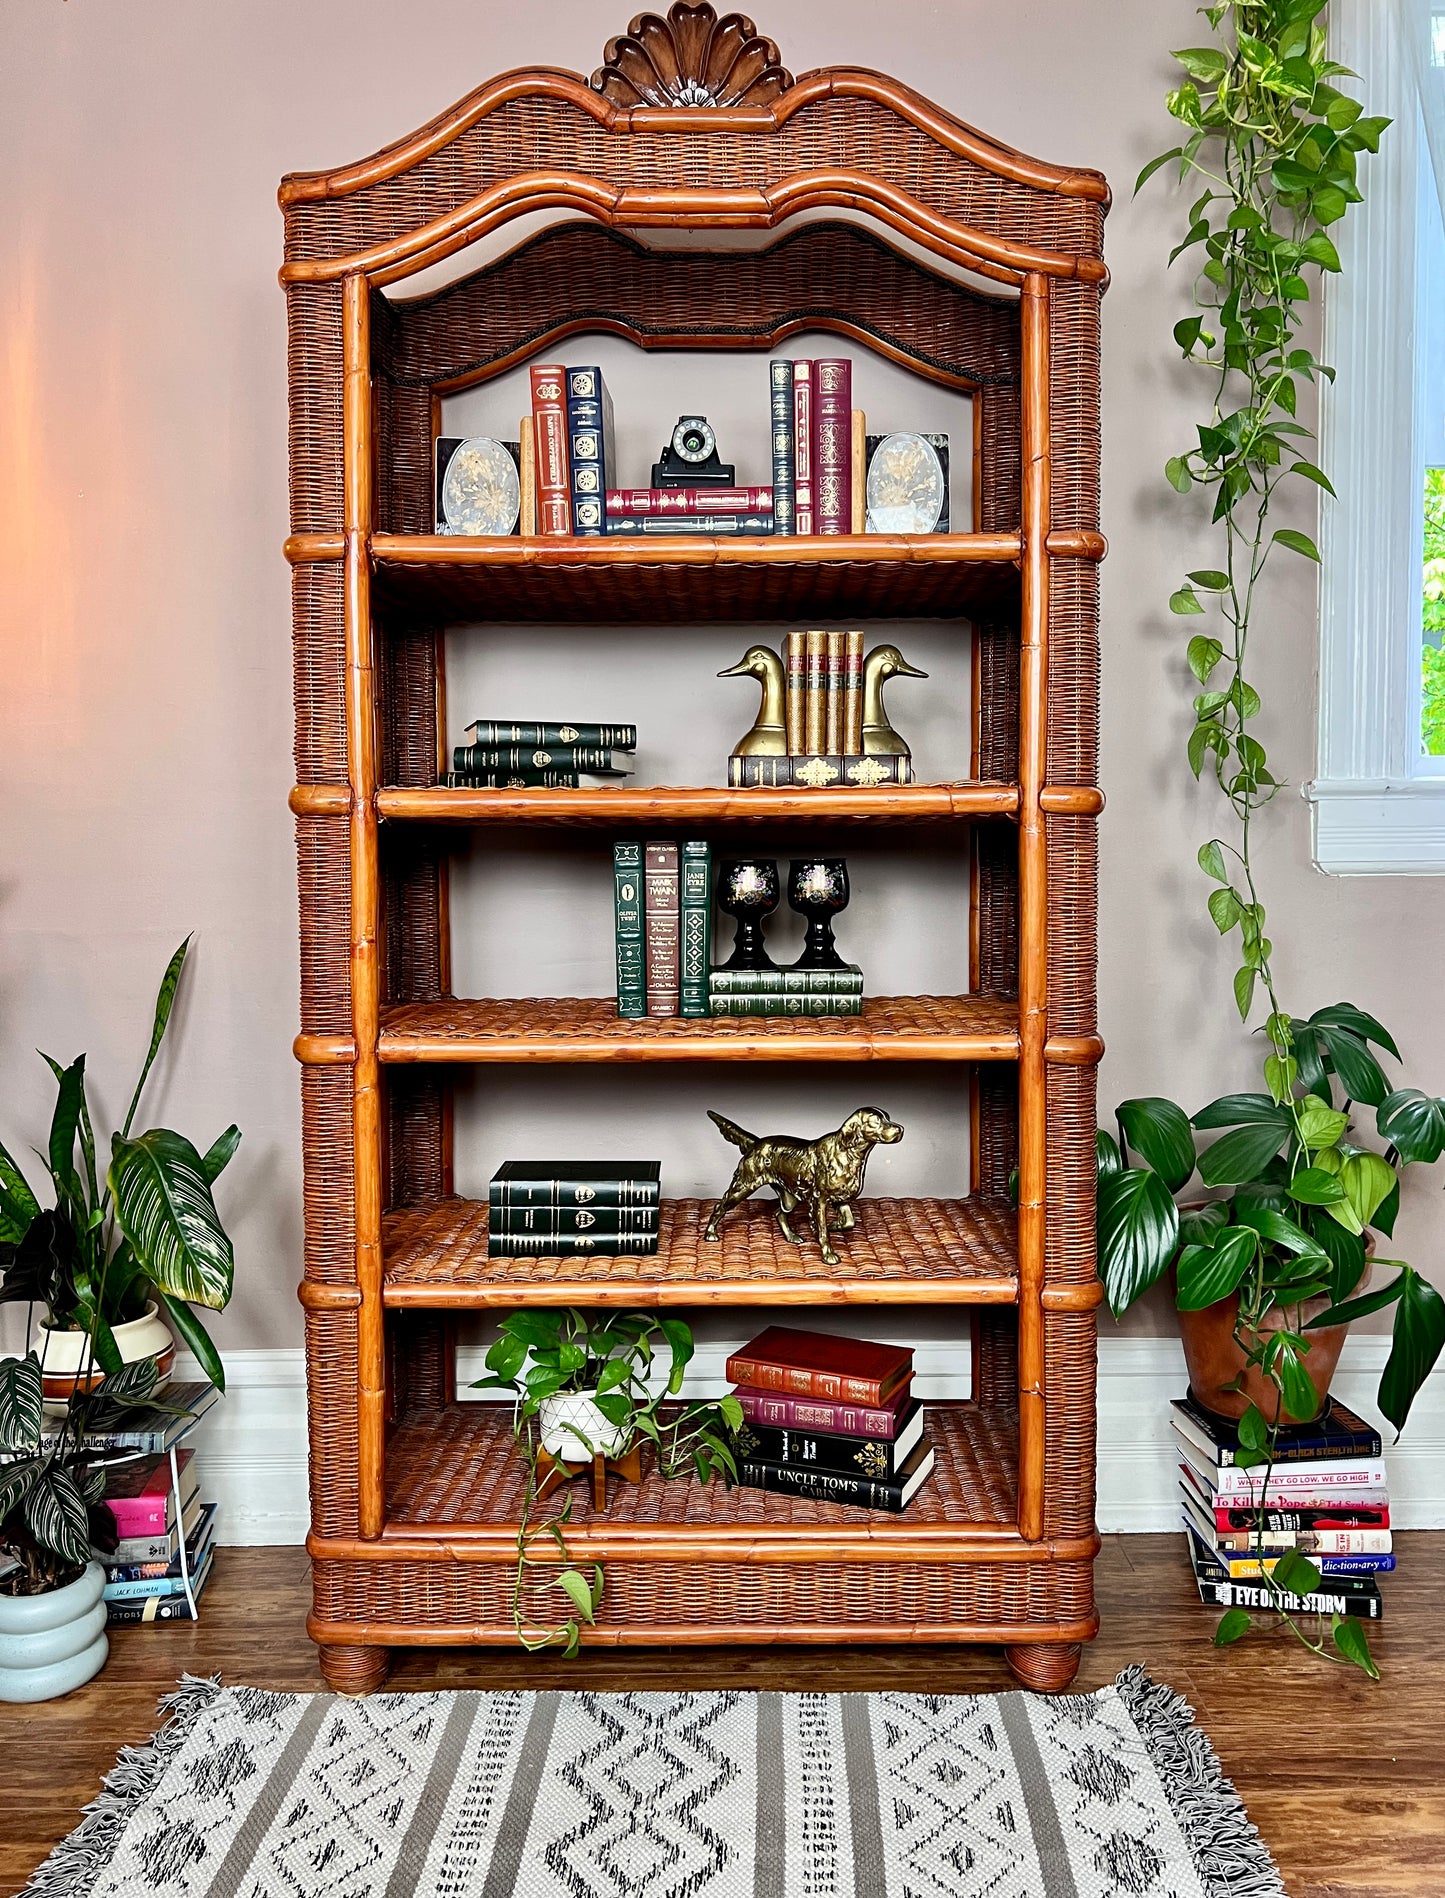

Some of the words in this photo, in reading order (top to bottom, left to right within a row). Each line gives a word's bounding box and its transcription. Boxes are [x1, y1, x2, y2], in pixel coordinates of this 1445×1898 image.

[547, 416, 555, 437] DAVID
[549, 437, 557, 483] COPPERFIELD
[652, 879, 672, 887] MARK
[650, 887, 676, 895] TWAIN
[82, 1436, 115, 1451] hallenger
[1288, 1449, 1315, 1458] BLACK
[1316, 1447, 1353, 1456] STEALTH
[1354, 1446, 1370, 1454] ONE
[778, 1470, 818, 1486] UNCLE
[822, 1477, 859, 1492] TOM'S
[1350, 1474, 1369, 1482] HIGH
[800, 1485, 837, 1499] CABIN
[1215, 1496, 1228, 1507] To
[1233, 1496, 1254, 1507] Kil
[1277, 1496, 1307, 1508] Pope
[1326, 1500, 1342, 1508] Tad
[115, 1588, 131, 1597] JACK
[1236, 1586, 1259, 1607] EYE
[1276, 1590, 1301, 1611] THE
[1302, 1593, 1347, 1615] STORM
